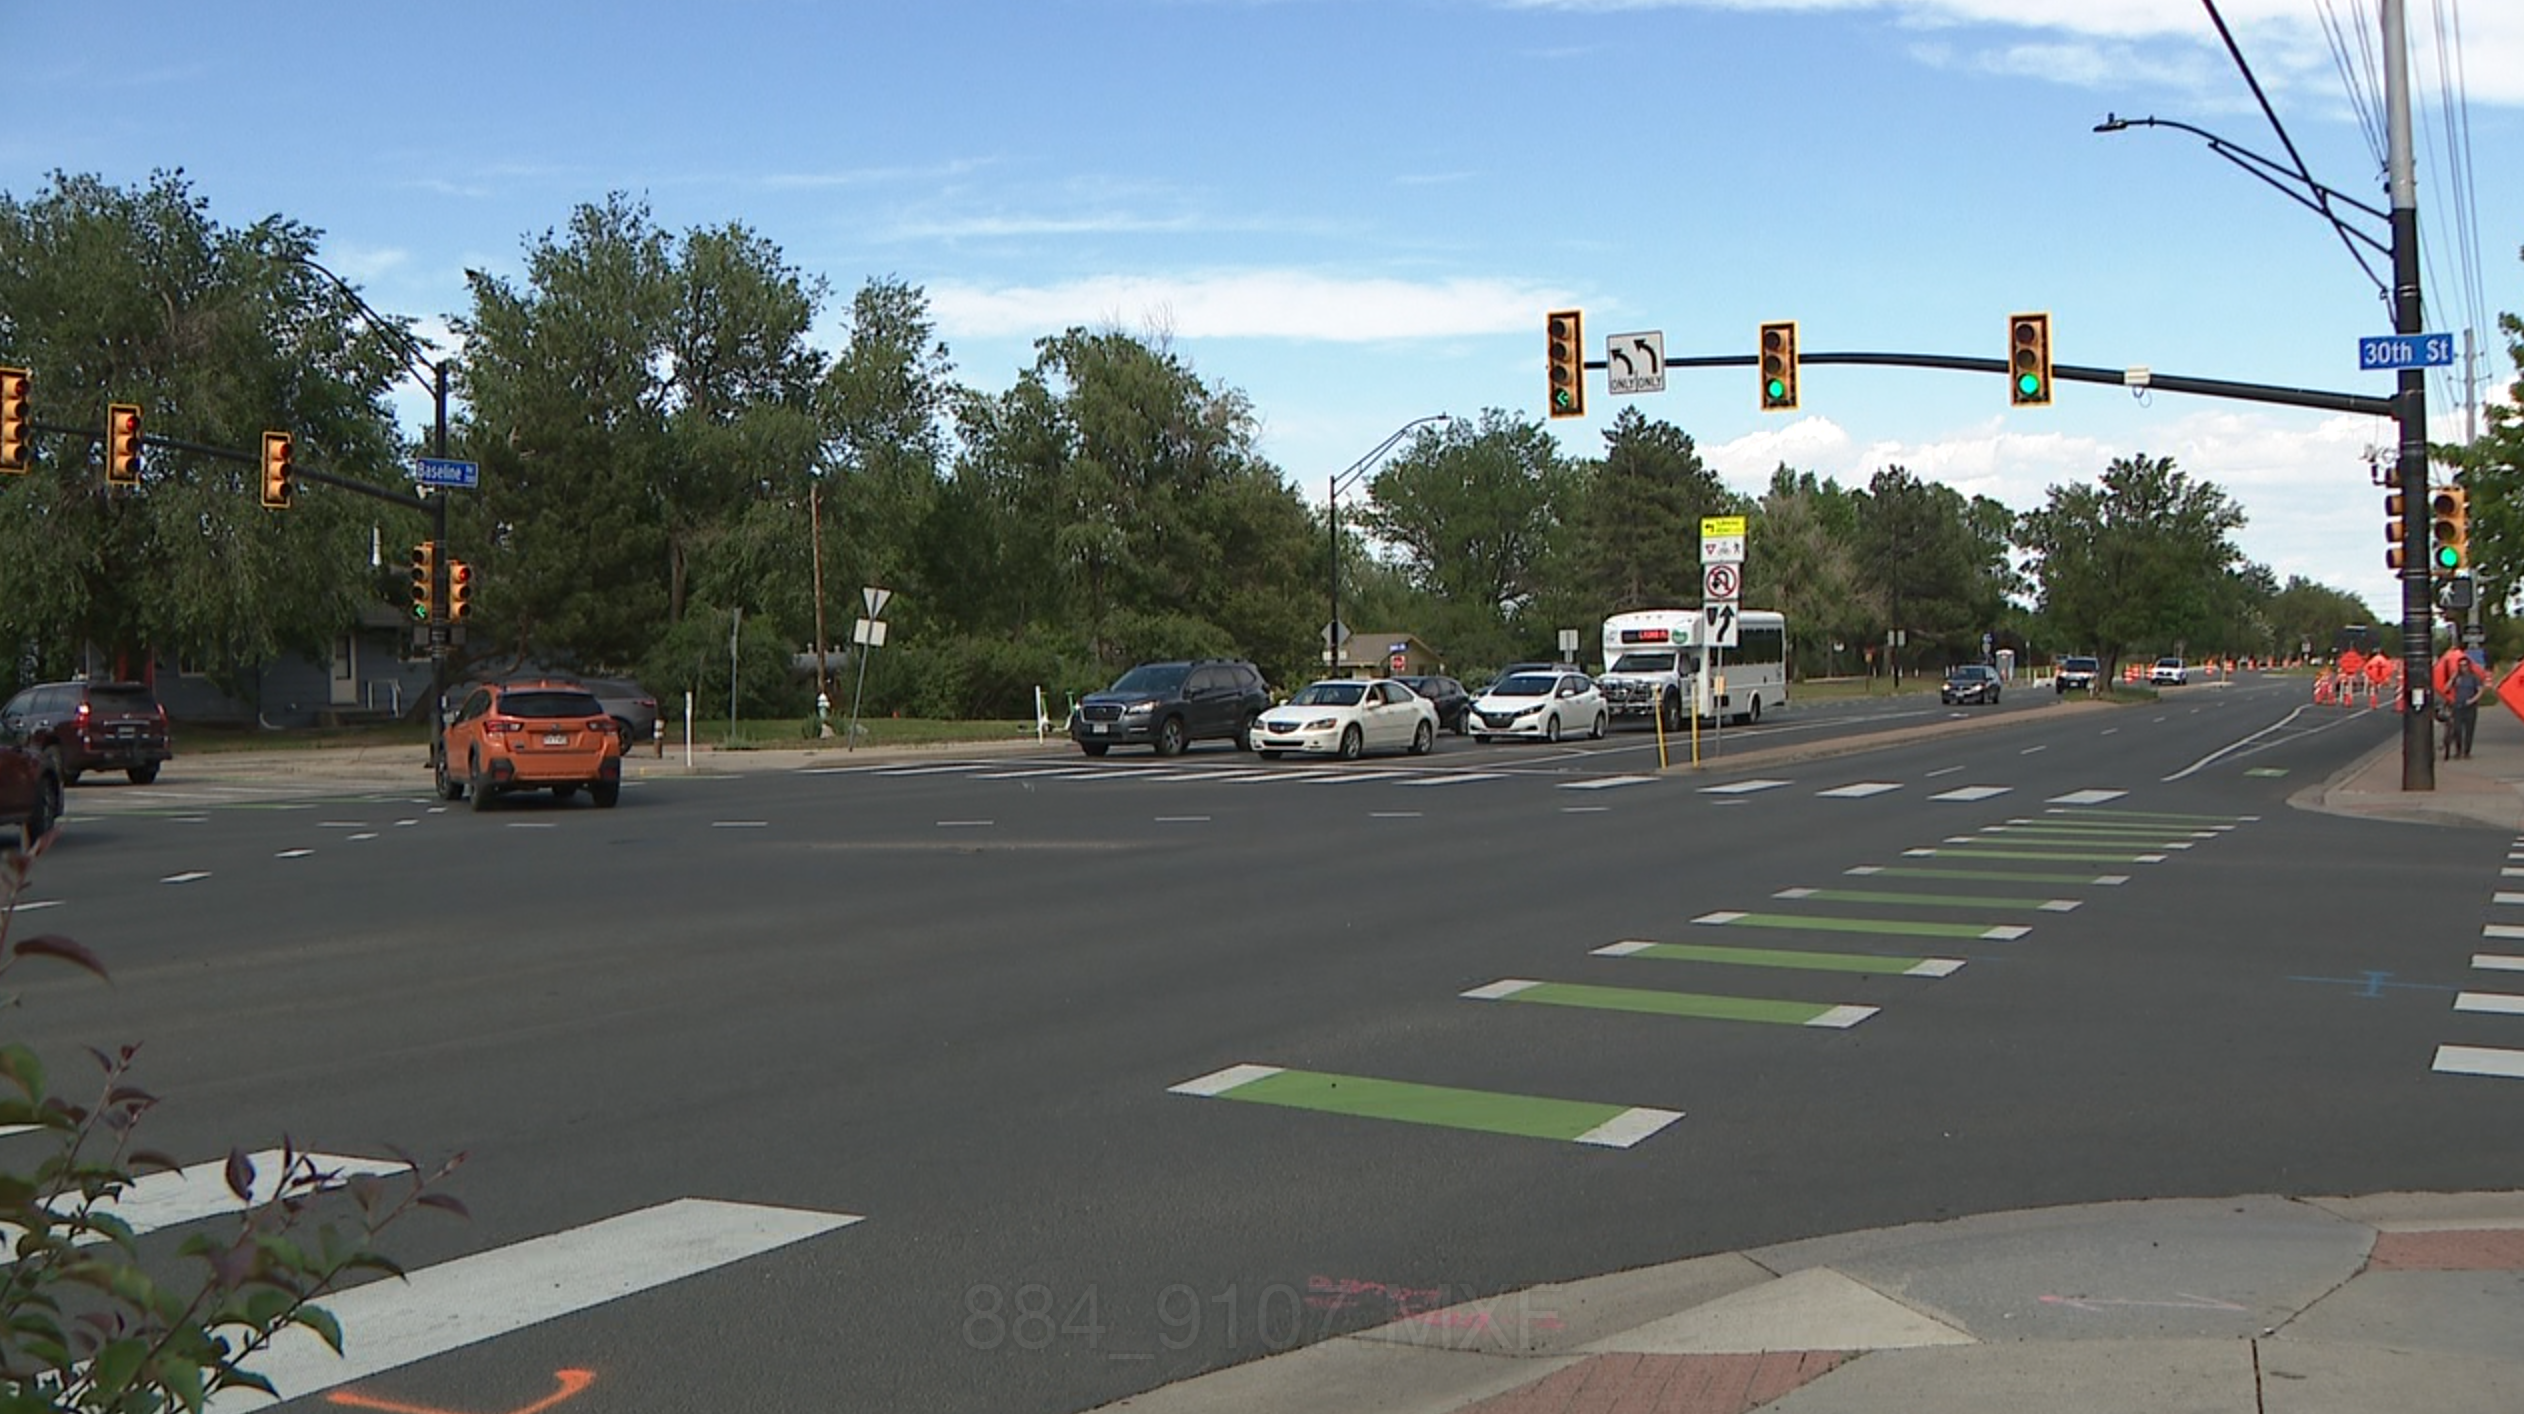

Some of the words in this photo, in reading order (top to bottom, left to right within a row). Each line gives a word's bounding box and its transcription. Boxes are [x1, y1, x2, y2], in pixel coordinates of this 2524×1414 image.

[2365, 341, 2413, 365] 30th
[2426, 339, 2449, 363] St
[1612, 377, 1634, 391] ONLY
[1639, 376, 1661, 389] ONLY
[417, 461, 462, 480] Baseline
